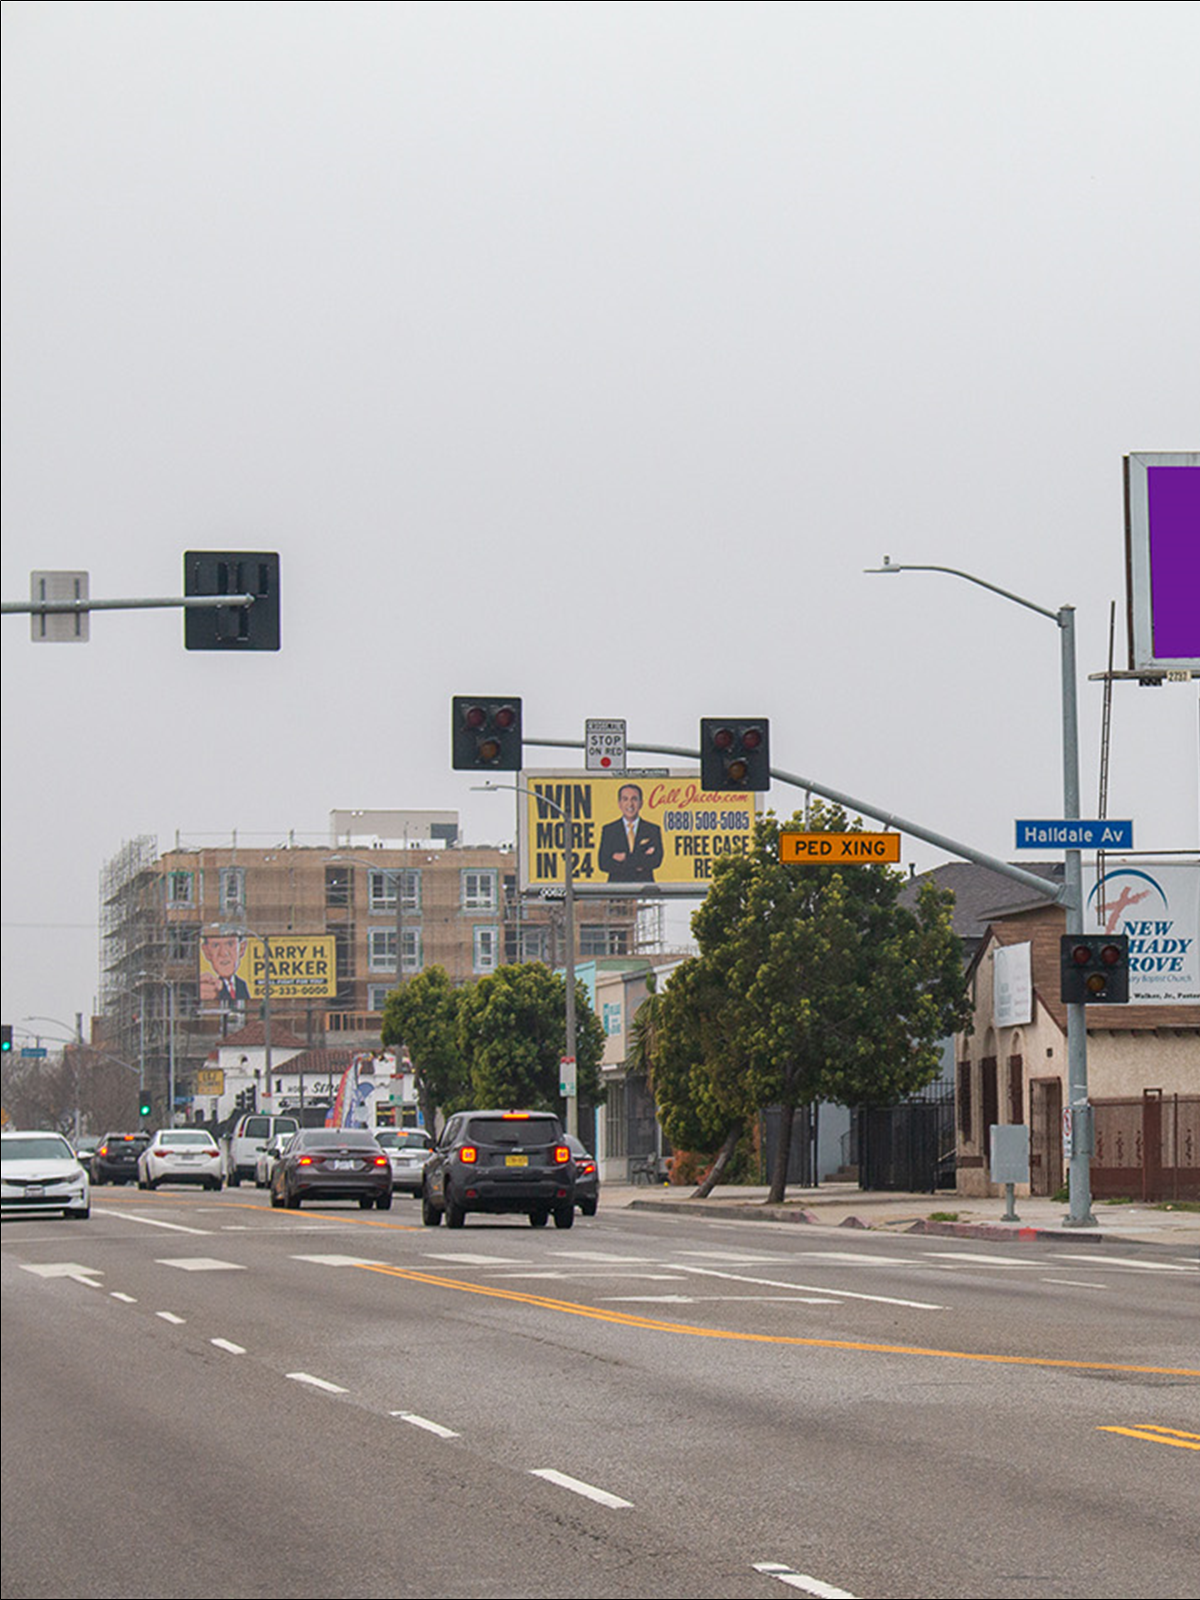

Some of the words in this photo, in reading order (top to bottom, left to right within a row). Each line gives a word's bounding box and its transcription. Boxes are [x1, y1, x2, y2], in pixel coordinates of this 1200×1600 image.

[591, 735, 621, 746] STOP
[589, 747, 602, 756] ON
[605, 747, 623, 756] RED
[534, 784, 592, 819] WIN
[648, 784, 681, 809] Call
[678, 784, 748, 808] Jacob.com
[664, 811, 693, 832] (888)
[695, 811, 749, 830] 508-5085
[536, 822, 595, 849] MORE
[1024, 827, 1093, 842] Halldale
[1101, 827, 1123, 842] Av
[675, 835, 710, 856] FREE
[713, 835, 749, 856] CASE
[795, 841, 832, 855] PED
[841, 841, 885, 856] XING
[536, 852, 557, 878] IN
[1122, 921, 1174, 936] NEW
[253, 946, 307, 959] LARRY
[1128, 939, 1193, 953] HADY
[253, 961, 328, 976] PARKER
[1128, 957, 1184, 972] ROVE
